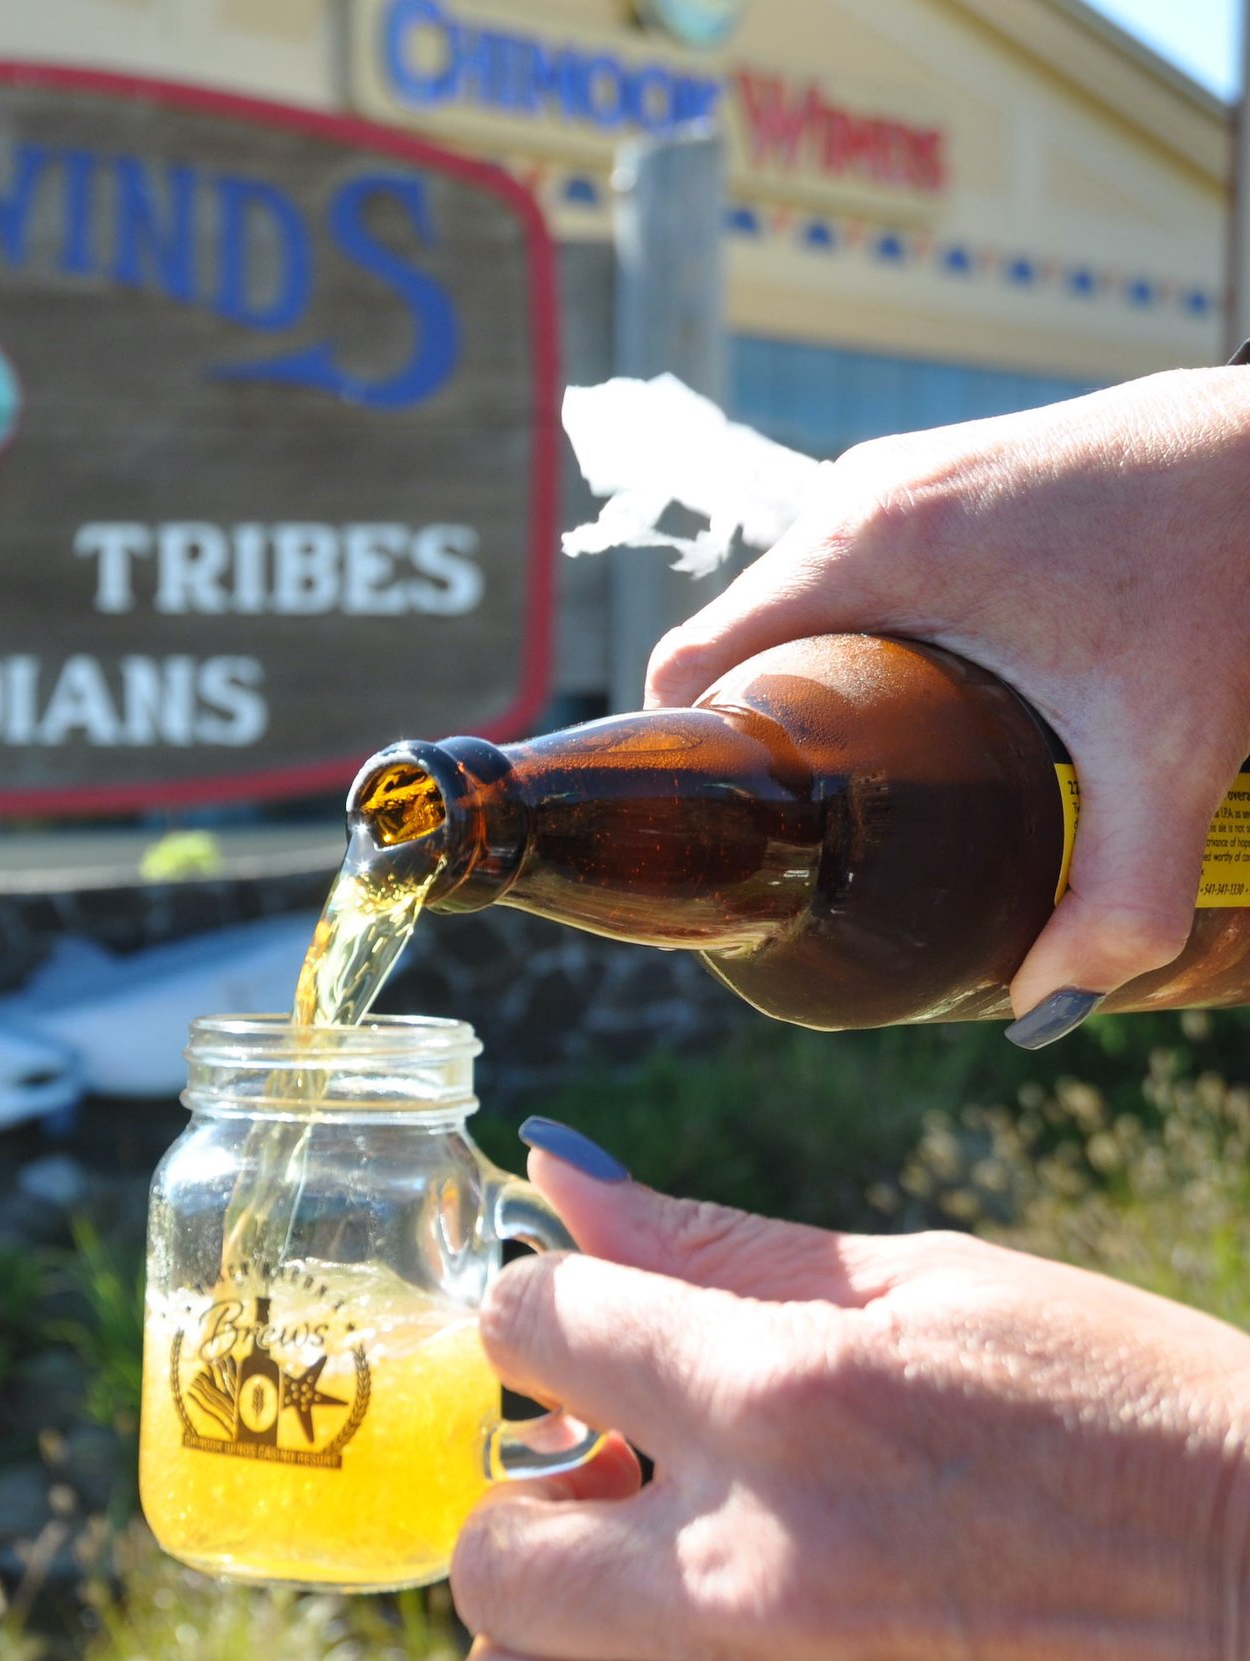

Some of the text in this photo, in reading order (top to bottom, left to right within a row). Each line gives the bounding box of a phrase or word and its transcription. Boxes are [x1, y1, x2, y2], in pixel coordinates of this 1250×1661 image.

[75, 521, 483, 616] TRIBES
[198, 1300, 329, 1364] Brews
[258, 1444, 298, 1463] CASINO
